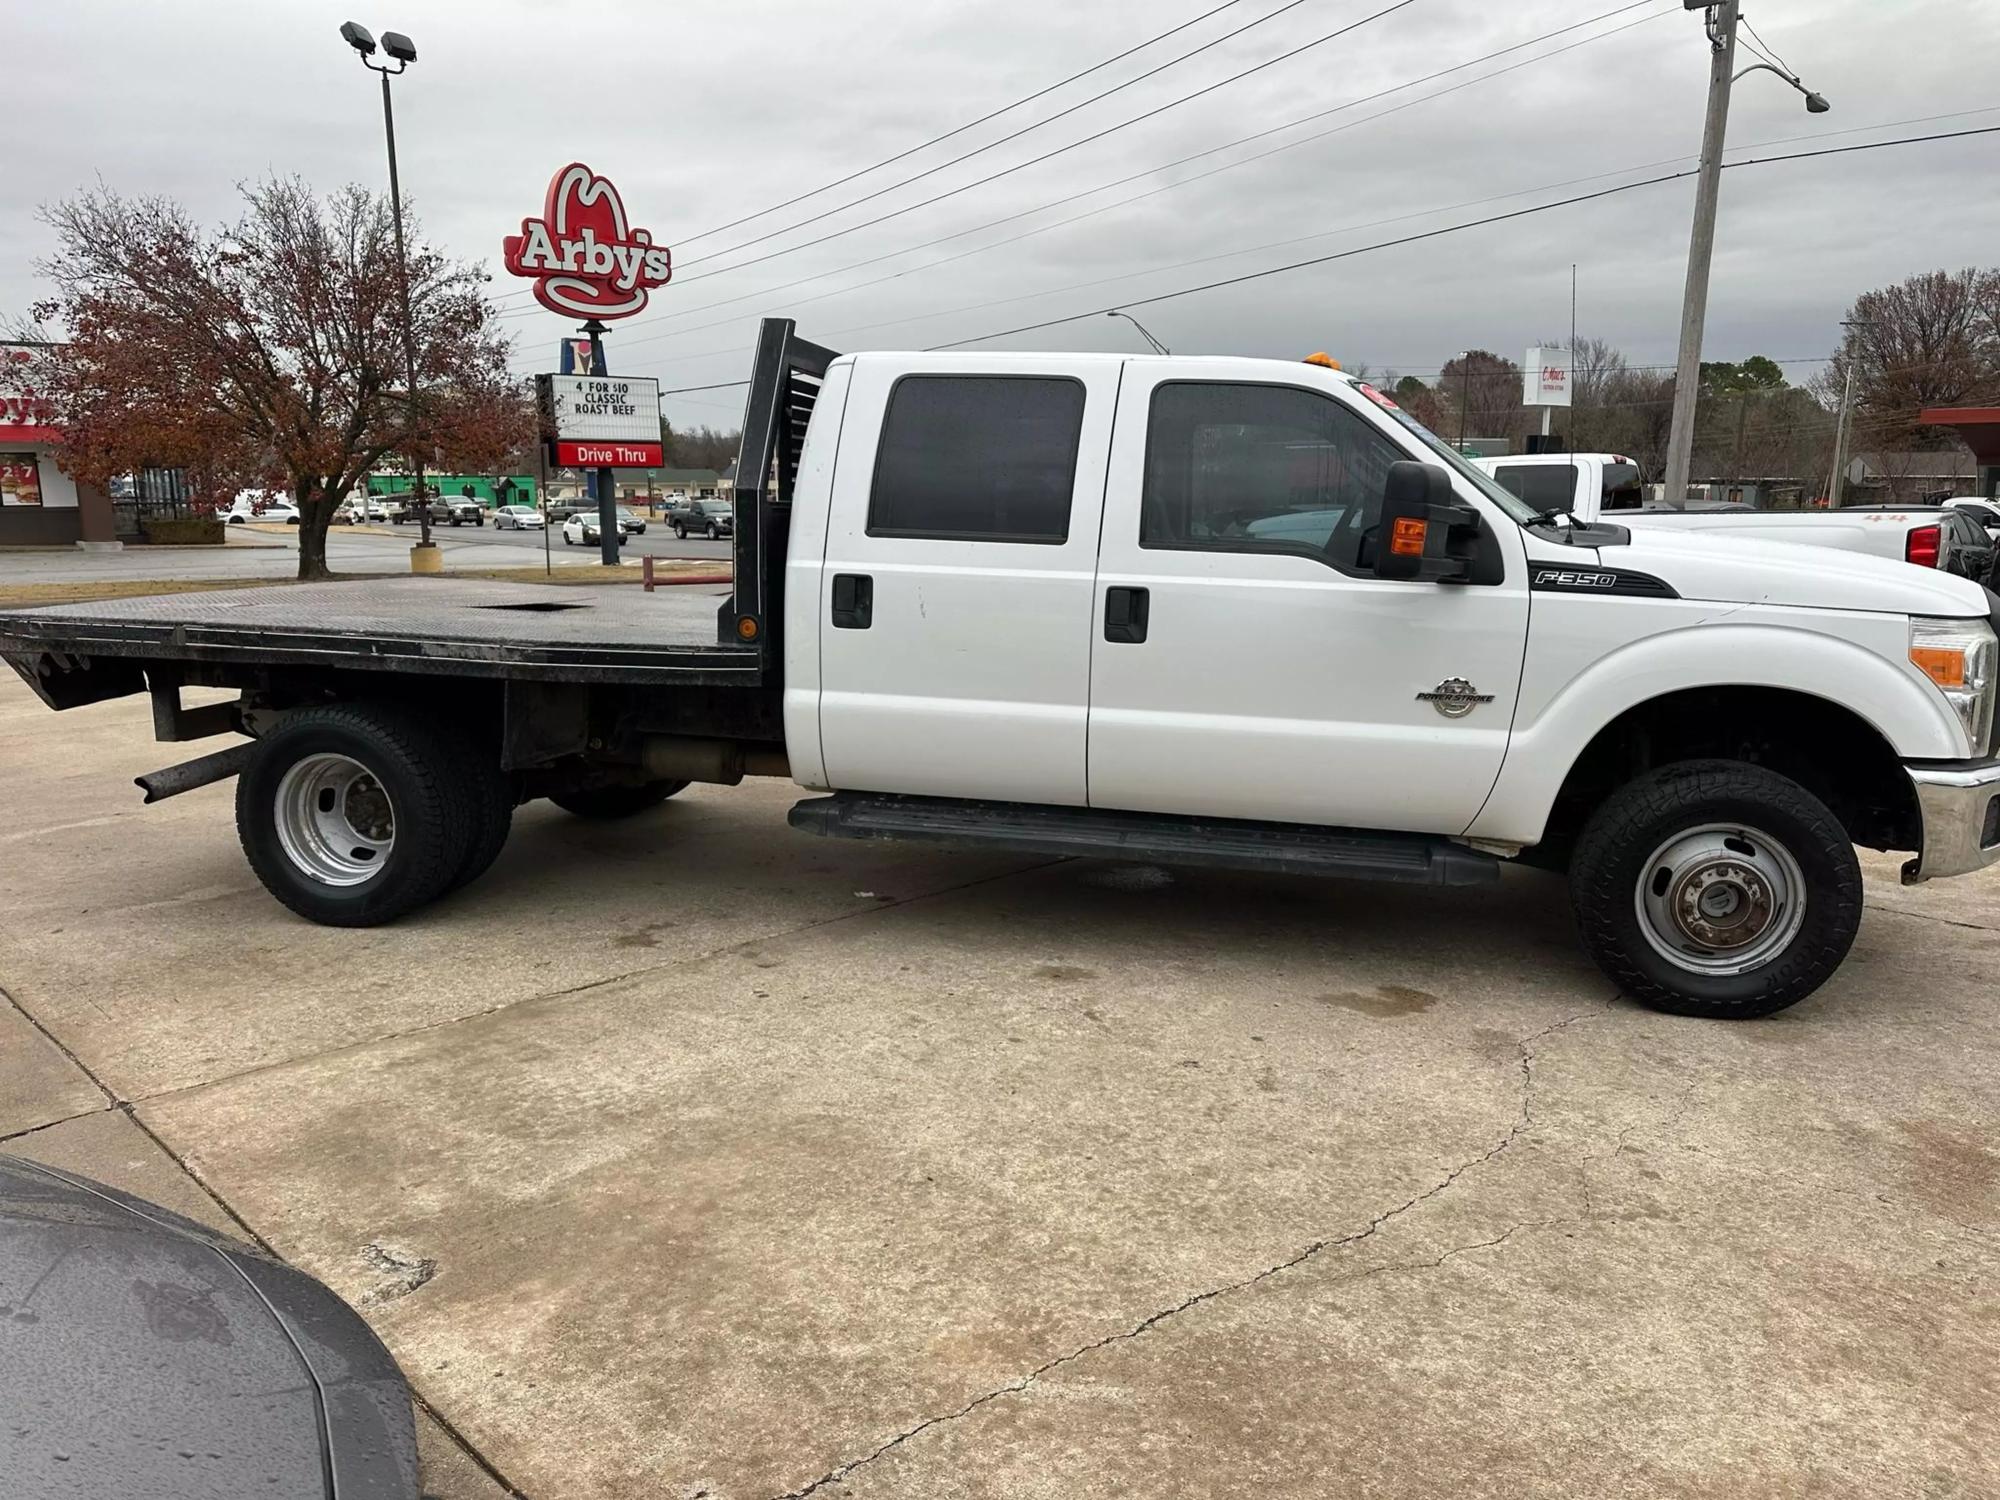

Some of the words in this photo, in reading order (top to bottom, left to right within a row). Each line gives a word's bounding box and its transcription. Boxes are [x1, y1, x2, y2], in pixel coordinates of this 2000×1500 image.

[521, 222, 668, 290] Arby's
[576, 382, 583, 392] 4
[589, 382, 609, 393] FOR
[613, 383, 628, 393] $10
[585, 393, 626, 404] CLASSIC
[575, 404, 608, 415] ROAST
[613, 405, 636, 415] BEEF
[578, 447, 613, 462] Drive
[616, 448, 647, 463] Thru
[1535, 571, 1617, 586] F-350
